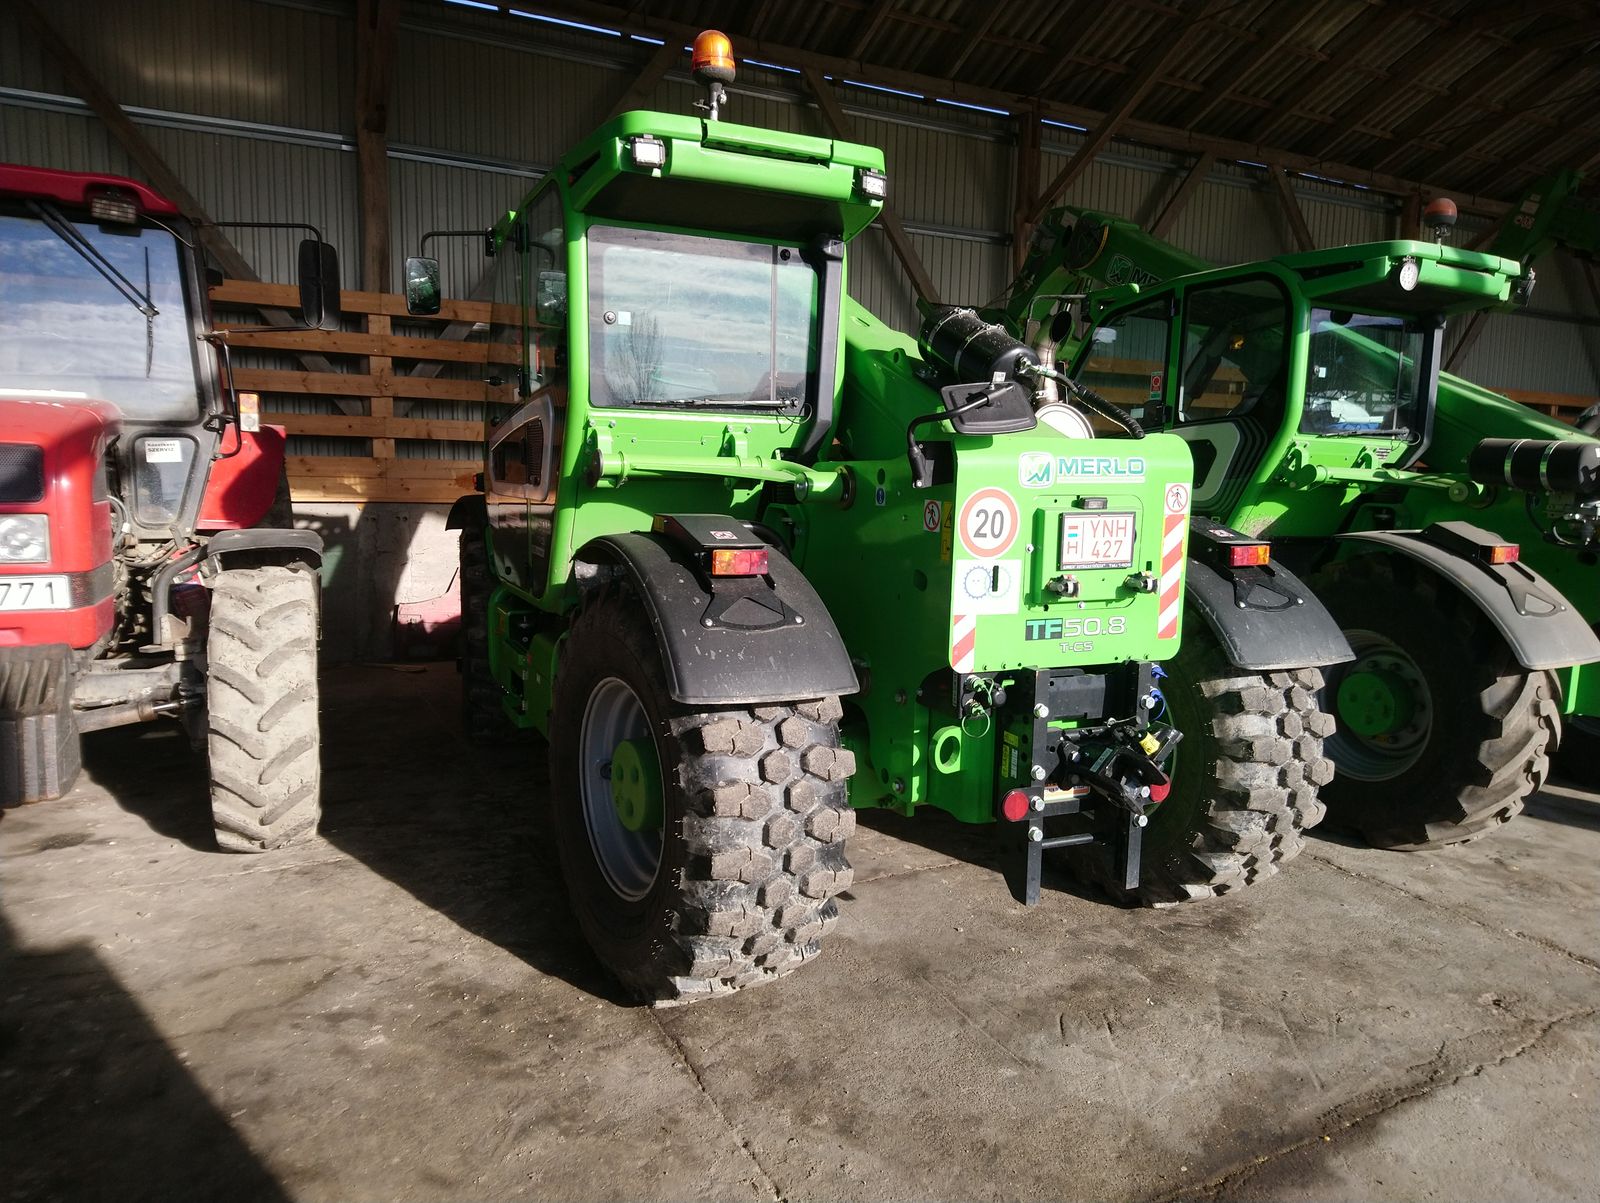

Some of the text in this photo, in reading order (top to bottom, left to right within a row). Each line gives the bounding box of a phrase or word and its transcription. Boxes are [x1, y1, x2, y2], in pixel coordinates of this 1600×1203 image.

[1058, 458, 1145, 475] MERLO
[973, 508, 1004, 539] 20
[1090, 519, 1128, 538] YNH
[1066, 540, 1123, 558] H 427
[0, 581, 55, 606] 771
[1059, 641, 1093, 653] T-CS
